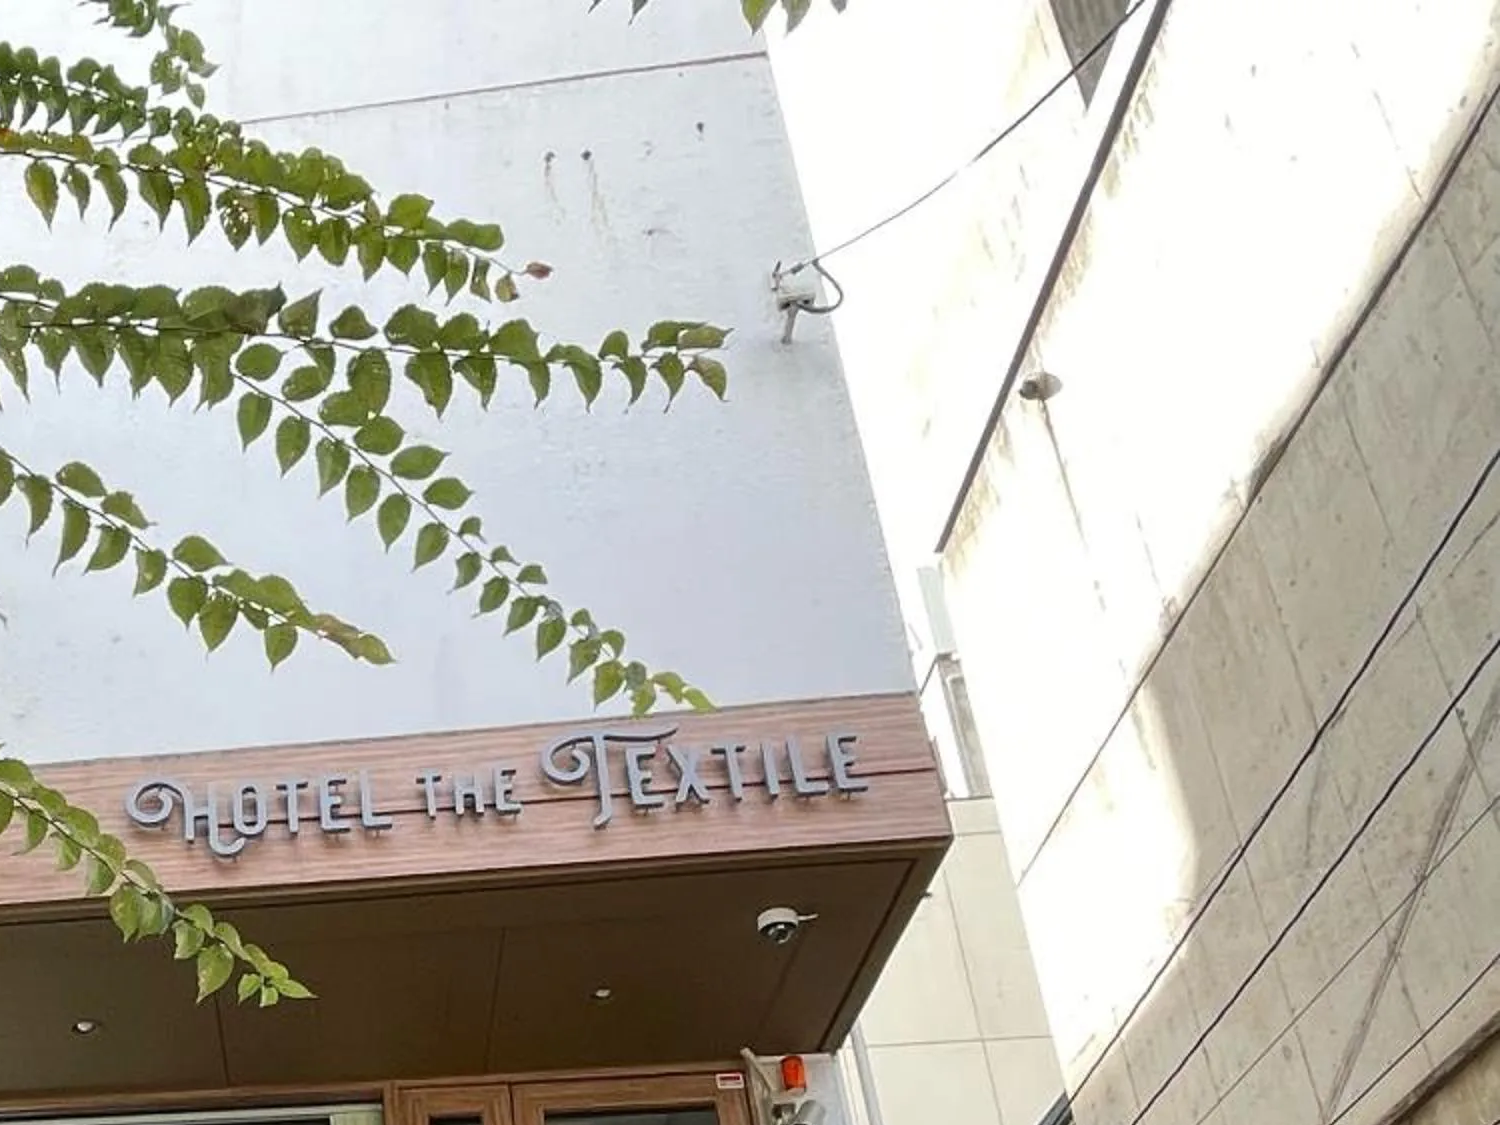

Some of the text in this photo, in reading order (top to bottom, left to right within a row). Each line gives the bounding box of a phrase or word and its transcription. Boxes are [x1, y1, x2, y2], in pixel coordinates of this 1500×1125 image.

[125, 723, 869, 860] HOTEL THE TEXTILE
